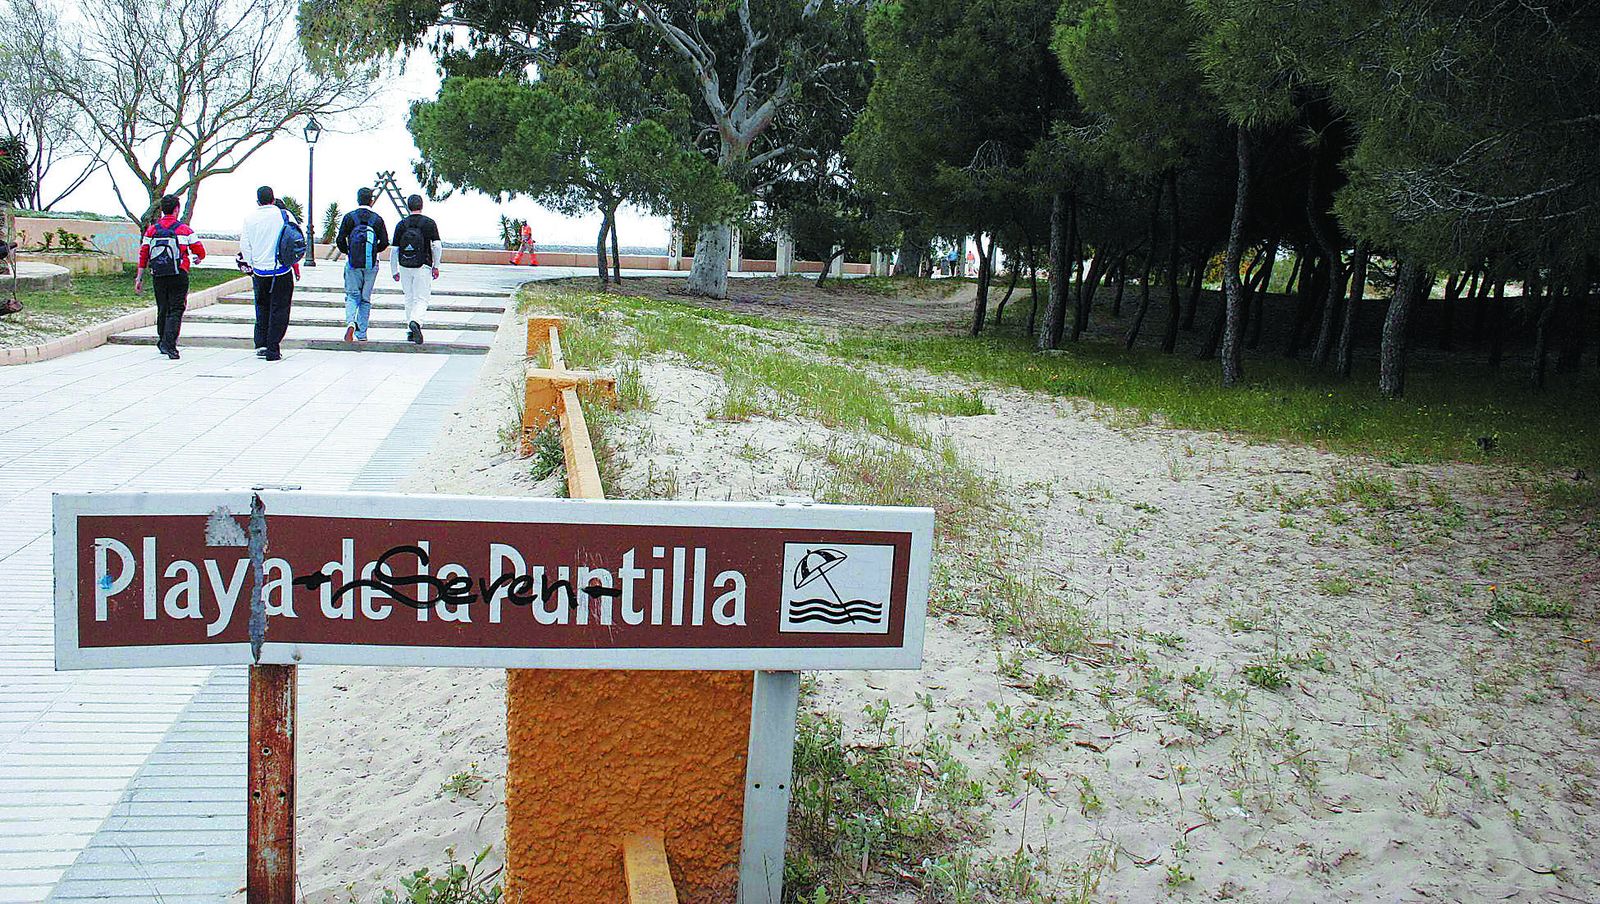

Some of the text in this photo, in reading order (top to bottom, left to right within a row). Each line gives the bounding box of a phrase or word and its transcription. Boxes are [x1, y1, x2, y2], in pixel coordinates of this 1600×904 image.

[94, 536, 747, 638] Playa de la Puntilla
